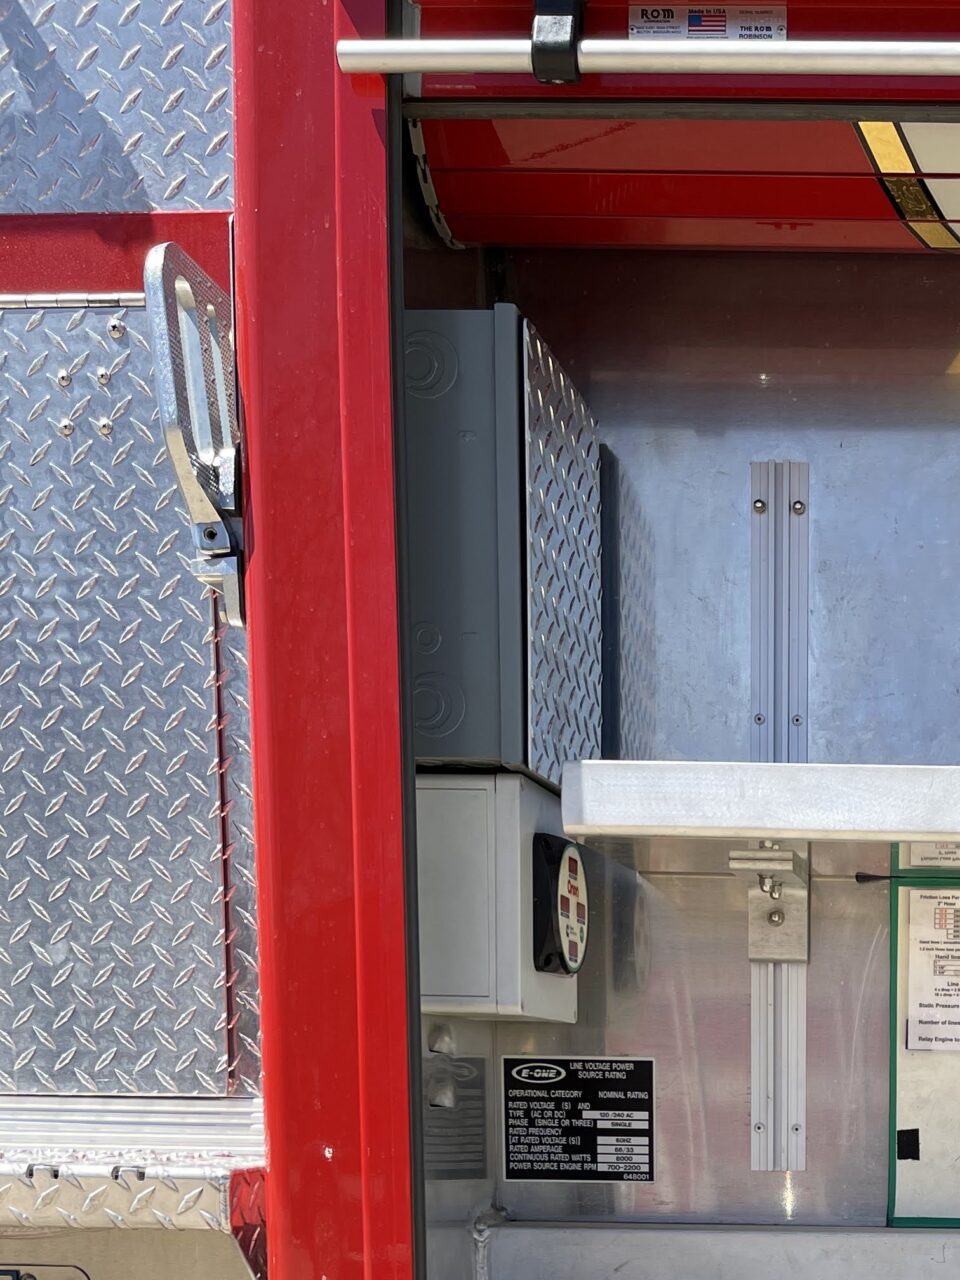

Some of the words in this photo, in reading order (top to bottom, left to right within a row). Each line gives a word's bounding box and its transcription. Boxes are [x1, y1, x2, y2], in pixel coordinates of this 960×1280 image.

[569, 1062, 583, 1070] LINE
[584, 1062, 611, 1070] VOLTAGE
[612, 1062, 634, 1070] POWER
[521, 1069, 557, 1077] E-ONE
[578, 1071, 603, 1079] SOURCE
[605, 1071, 626, 1079] RATING
[508, 1090, 549, 1098] OPERATIONAL
[550, 1090, 582, 1098] CATEGORY
[598, 1091, 625, 1099] NOMINAL
[627, 1091, 648, 1099] RATING
[508, 1102, 528, 1110] RATED
[529, 1102, 555, 1110] VOLTAGE
[577, 1102, 591, 1110] AND
[509, 1110, 524, 1118] TYPE
[530, 1110, 542, 1118] (AC
[543, 1110, 552, 1118] OR
[554, 1110, 566, 1118] DC)
[509, 1119, 528, 1127] PHASE
[535, 1119, 559, 1127] (SINGLE
[560, 1119, 570, 1127] OR
[571, 1119, 593, 1127] THREE)
[520, 1136, 539, 1144] RATED
[541, 1136, 567, 1144] VOLTAGE
[509, 1145, 528, 1153] RATED
[530, 1145, 563, 1153] AMPERAGE
[509, 1153, 549, 1161] CONTINUOUS
[550, 1153, 569, 1161] RATED
[571, 1153, 591, 1161] WATTS
[509, 1162, 531, 1170] POWER
[533, 1162, 558, 1170] SOURCE
[560, 1162, 582, 1170] ENGINE
[584, 1162, 597, 1170] RPM
